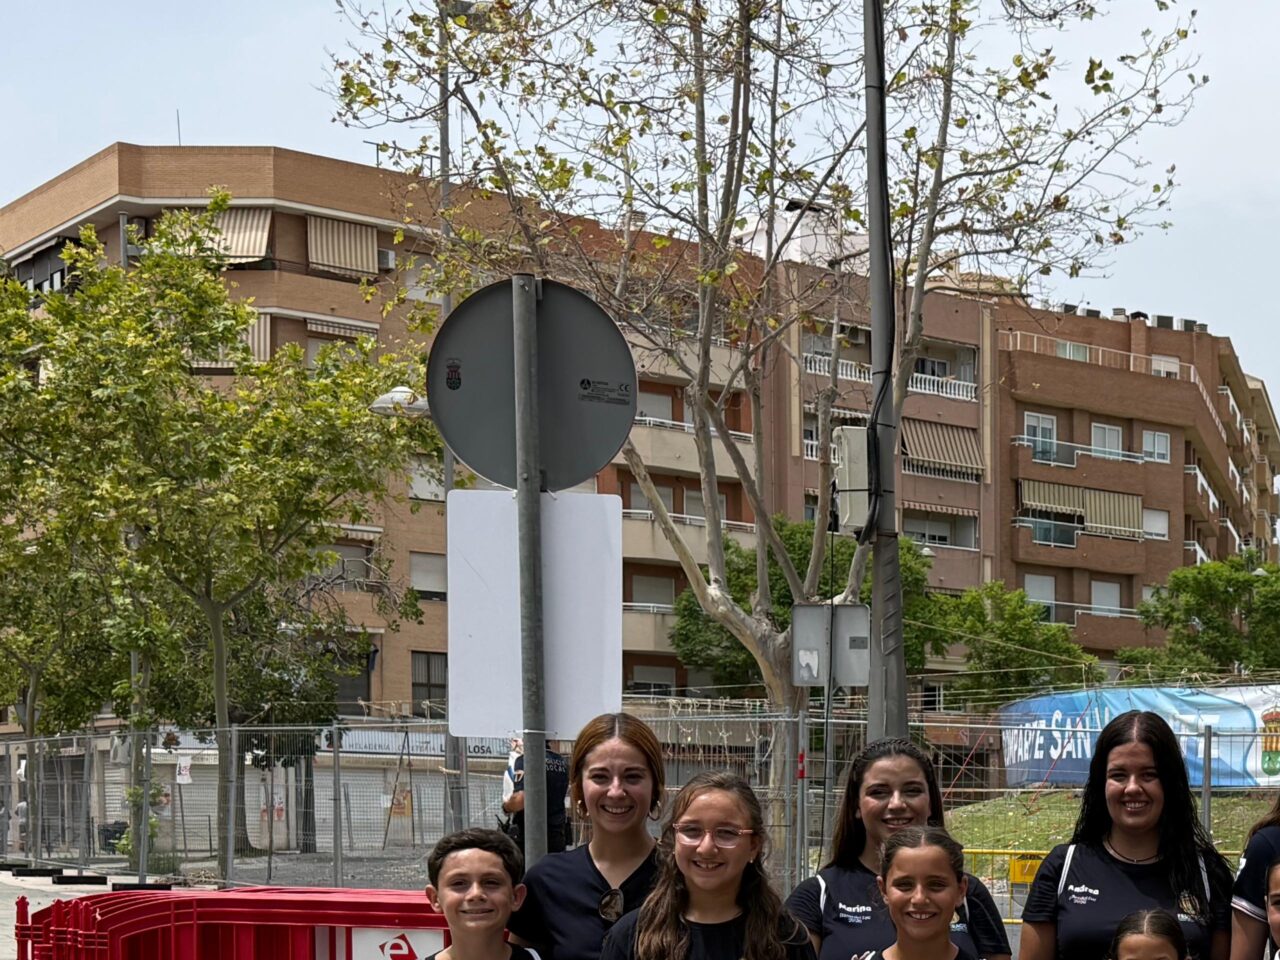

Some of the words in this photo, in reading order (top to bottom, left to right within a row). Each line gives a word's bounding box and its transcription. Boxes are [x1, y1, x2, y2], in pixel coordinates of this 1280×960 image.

[1050, 710, 1092, 760] SAN
[467, 745, 492, 754] LOSA
[1067, 884, 1100, 896] Andrea
[838, 902, 872, 913] Marina
